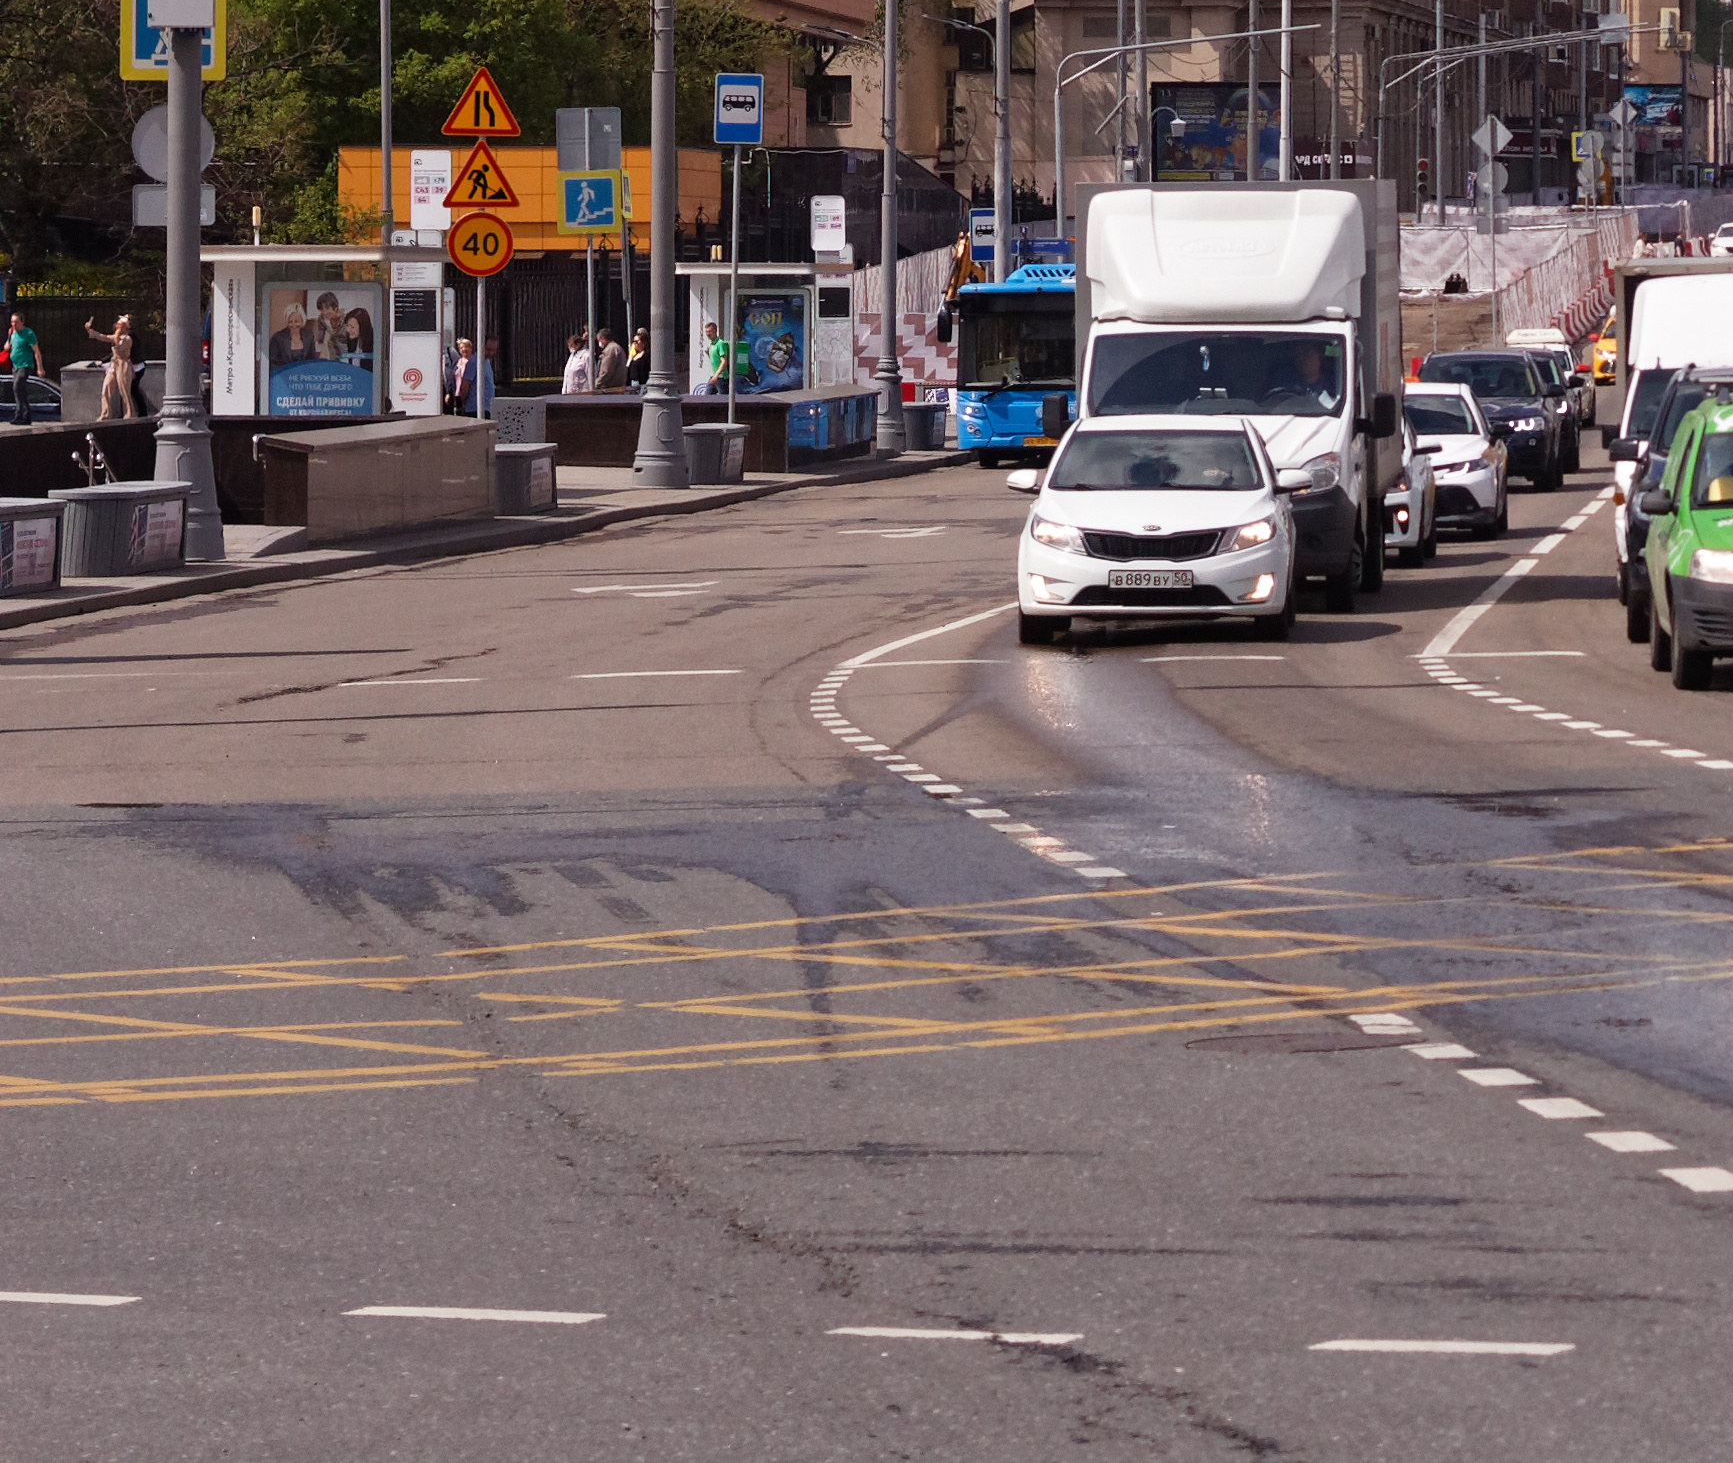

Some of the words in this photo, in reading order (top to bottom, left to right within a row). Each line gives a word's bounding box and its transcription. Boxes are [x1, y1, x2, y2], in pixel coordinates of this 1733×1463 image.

[462, 232, 499, 256] 40
[289, 374, 299, 382] НЕ
[276, 394, 314, 409] СДЕЛАЙ
[315, 396, 366, 408] ПРИВИВКУ
[1115, 573, 1169, 586] В889ВУ
[1174, 572, 1188, 583] 50
